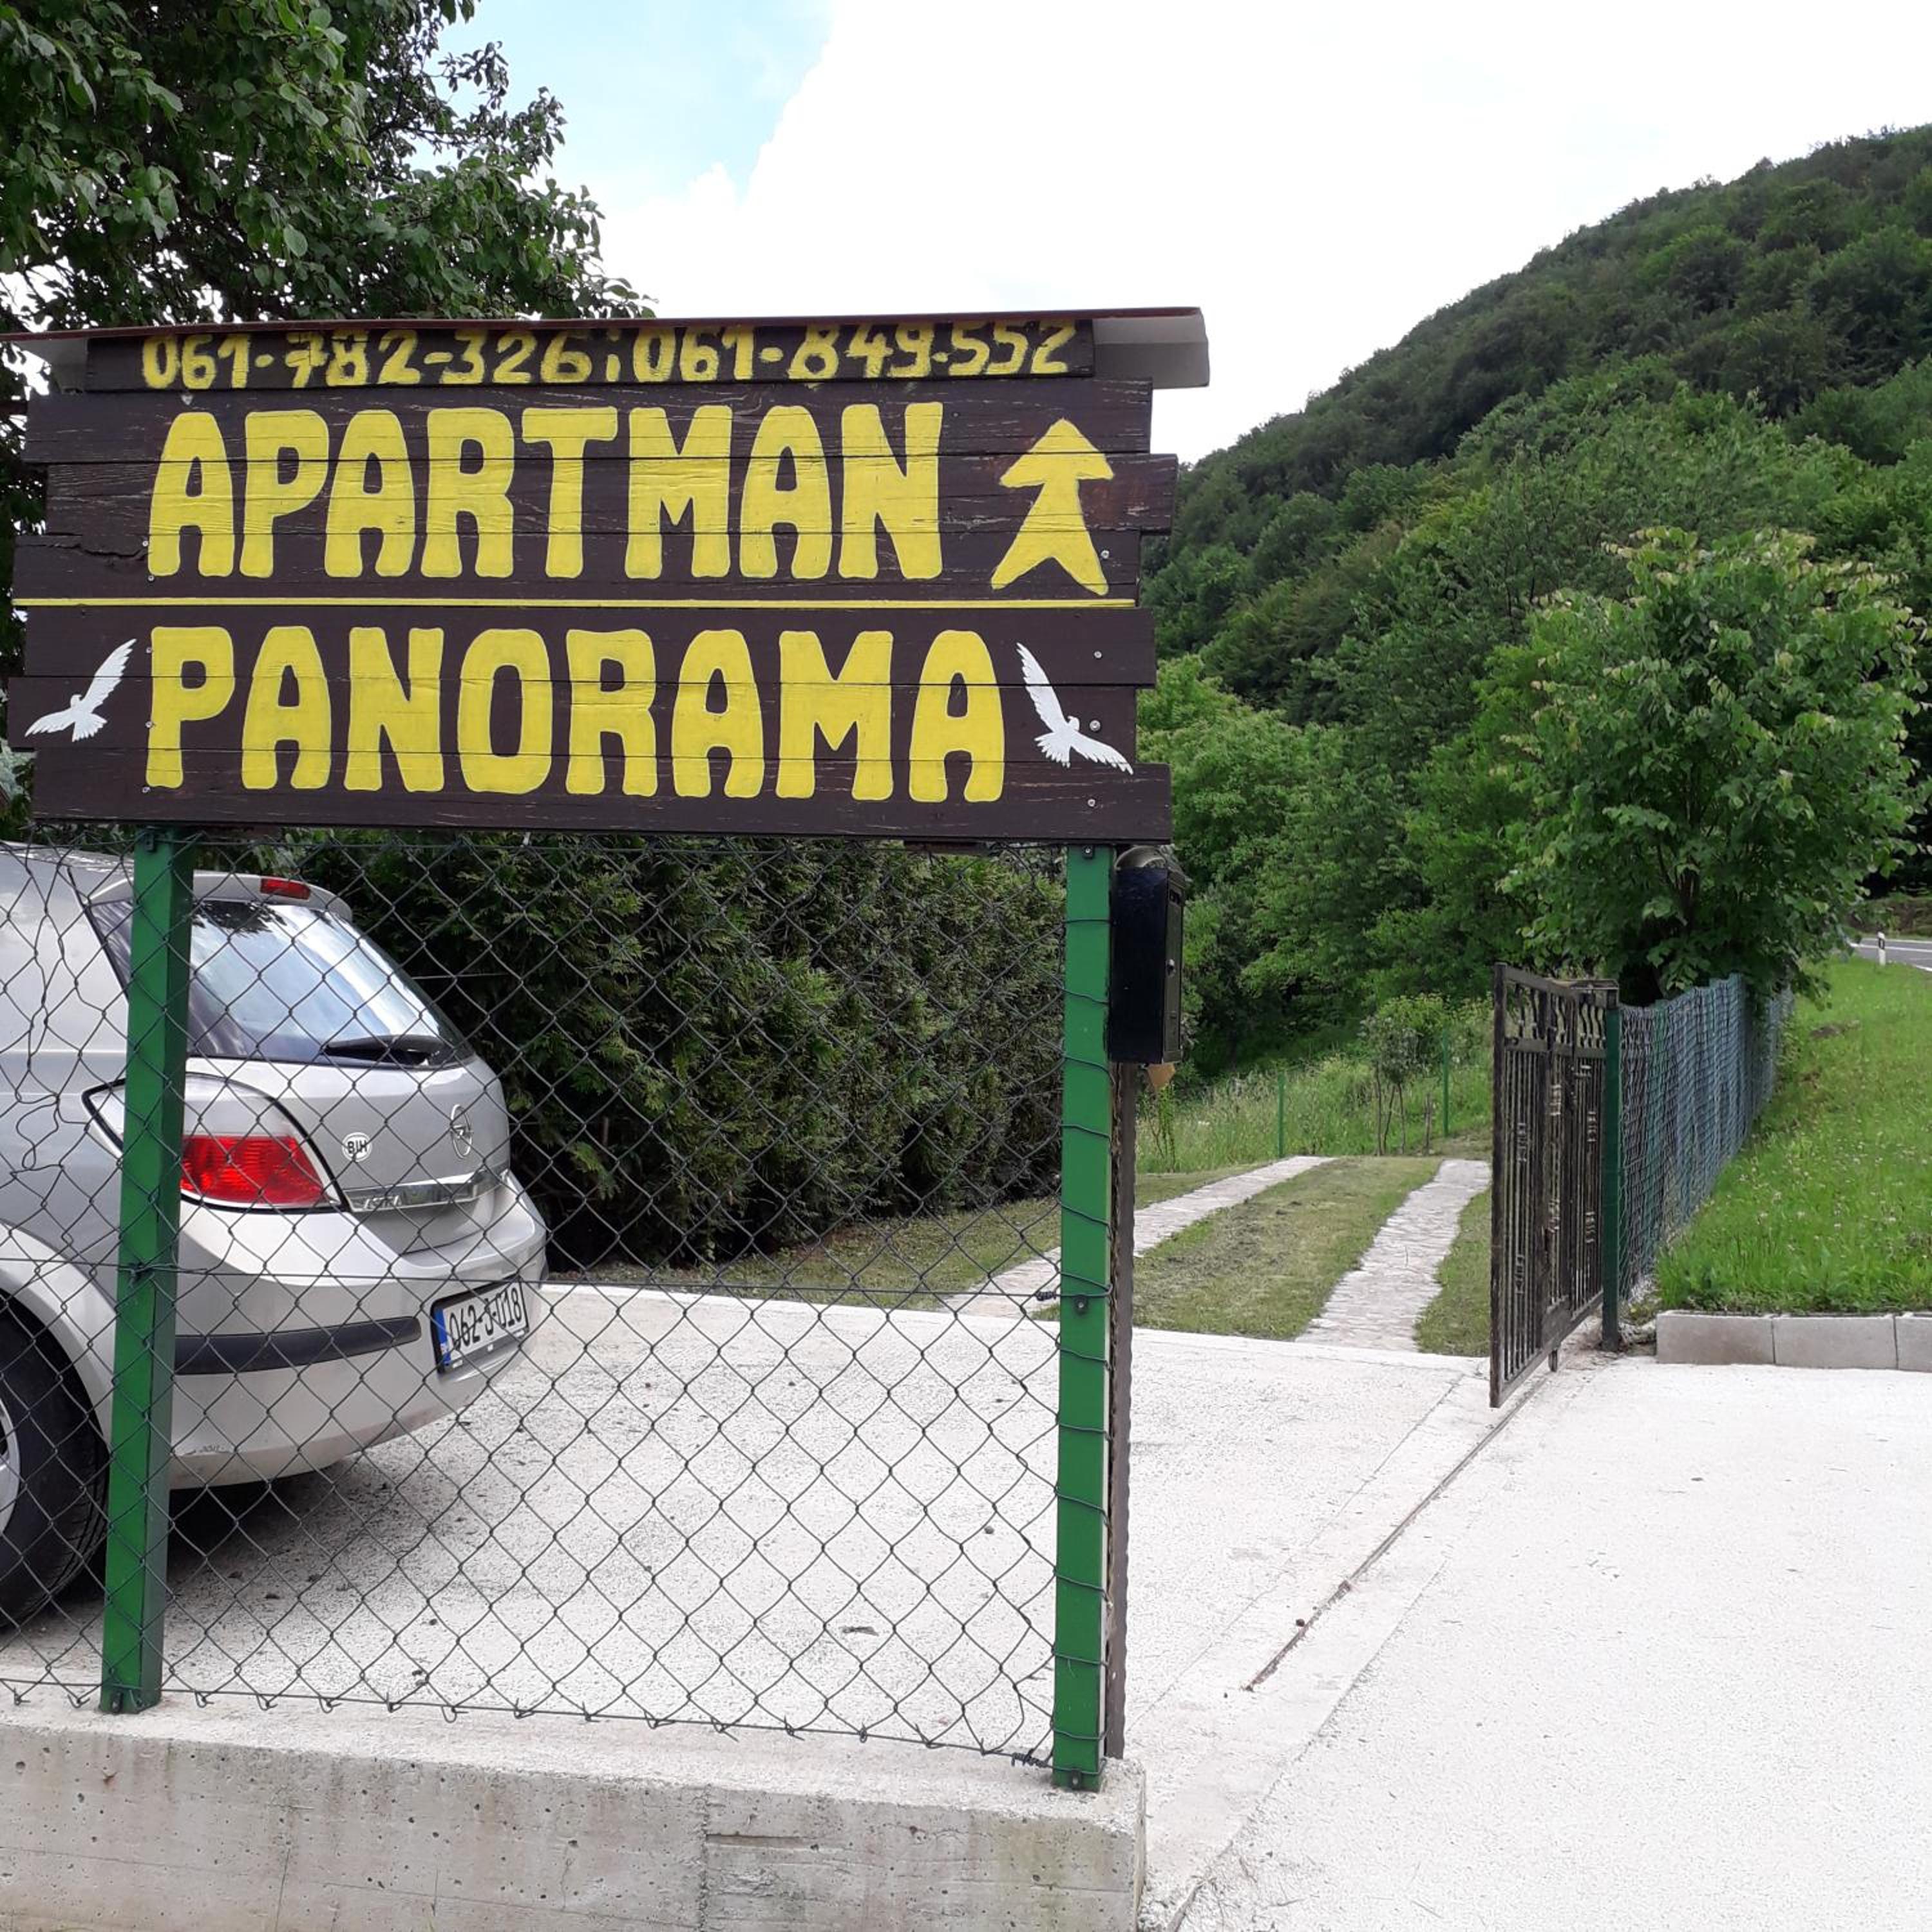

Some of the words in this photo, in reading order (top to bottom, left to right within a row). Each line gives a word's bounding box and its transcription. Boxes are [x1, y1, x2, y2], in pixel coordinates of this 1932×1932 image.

[147, 403, 943, 578] APARTMAN
[144, 627, 1005, 804] PANORAMA
[348, 1139, 367, 1153] BIH
